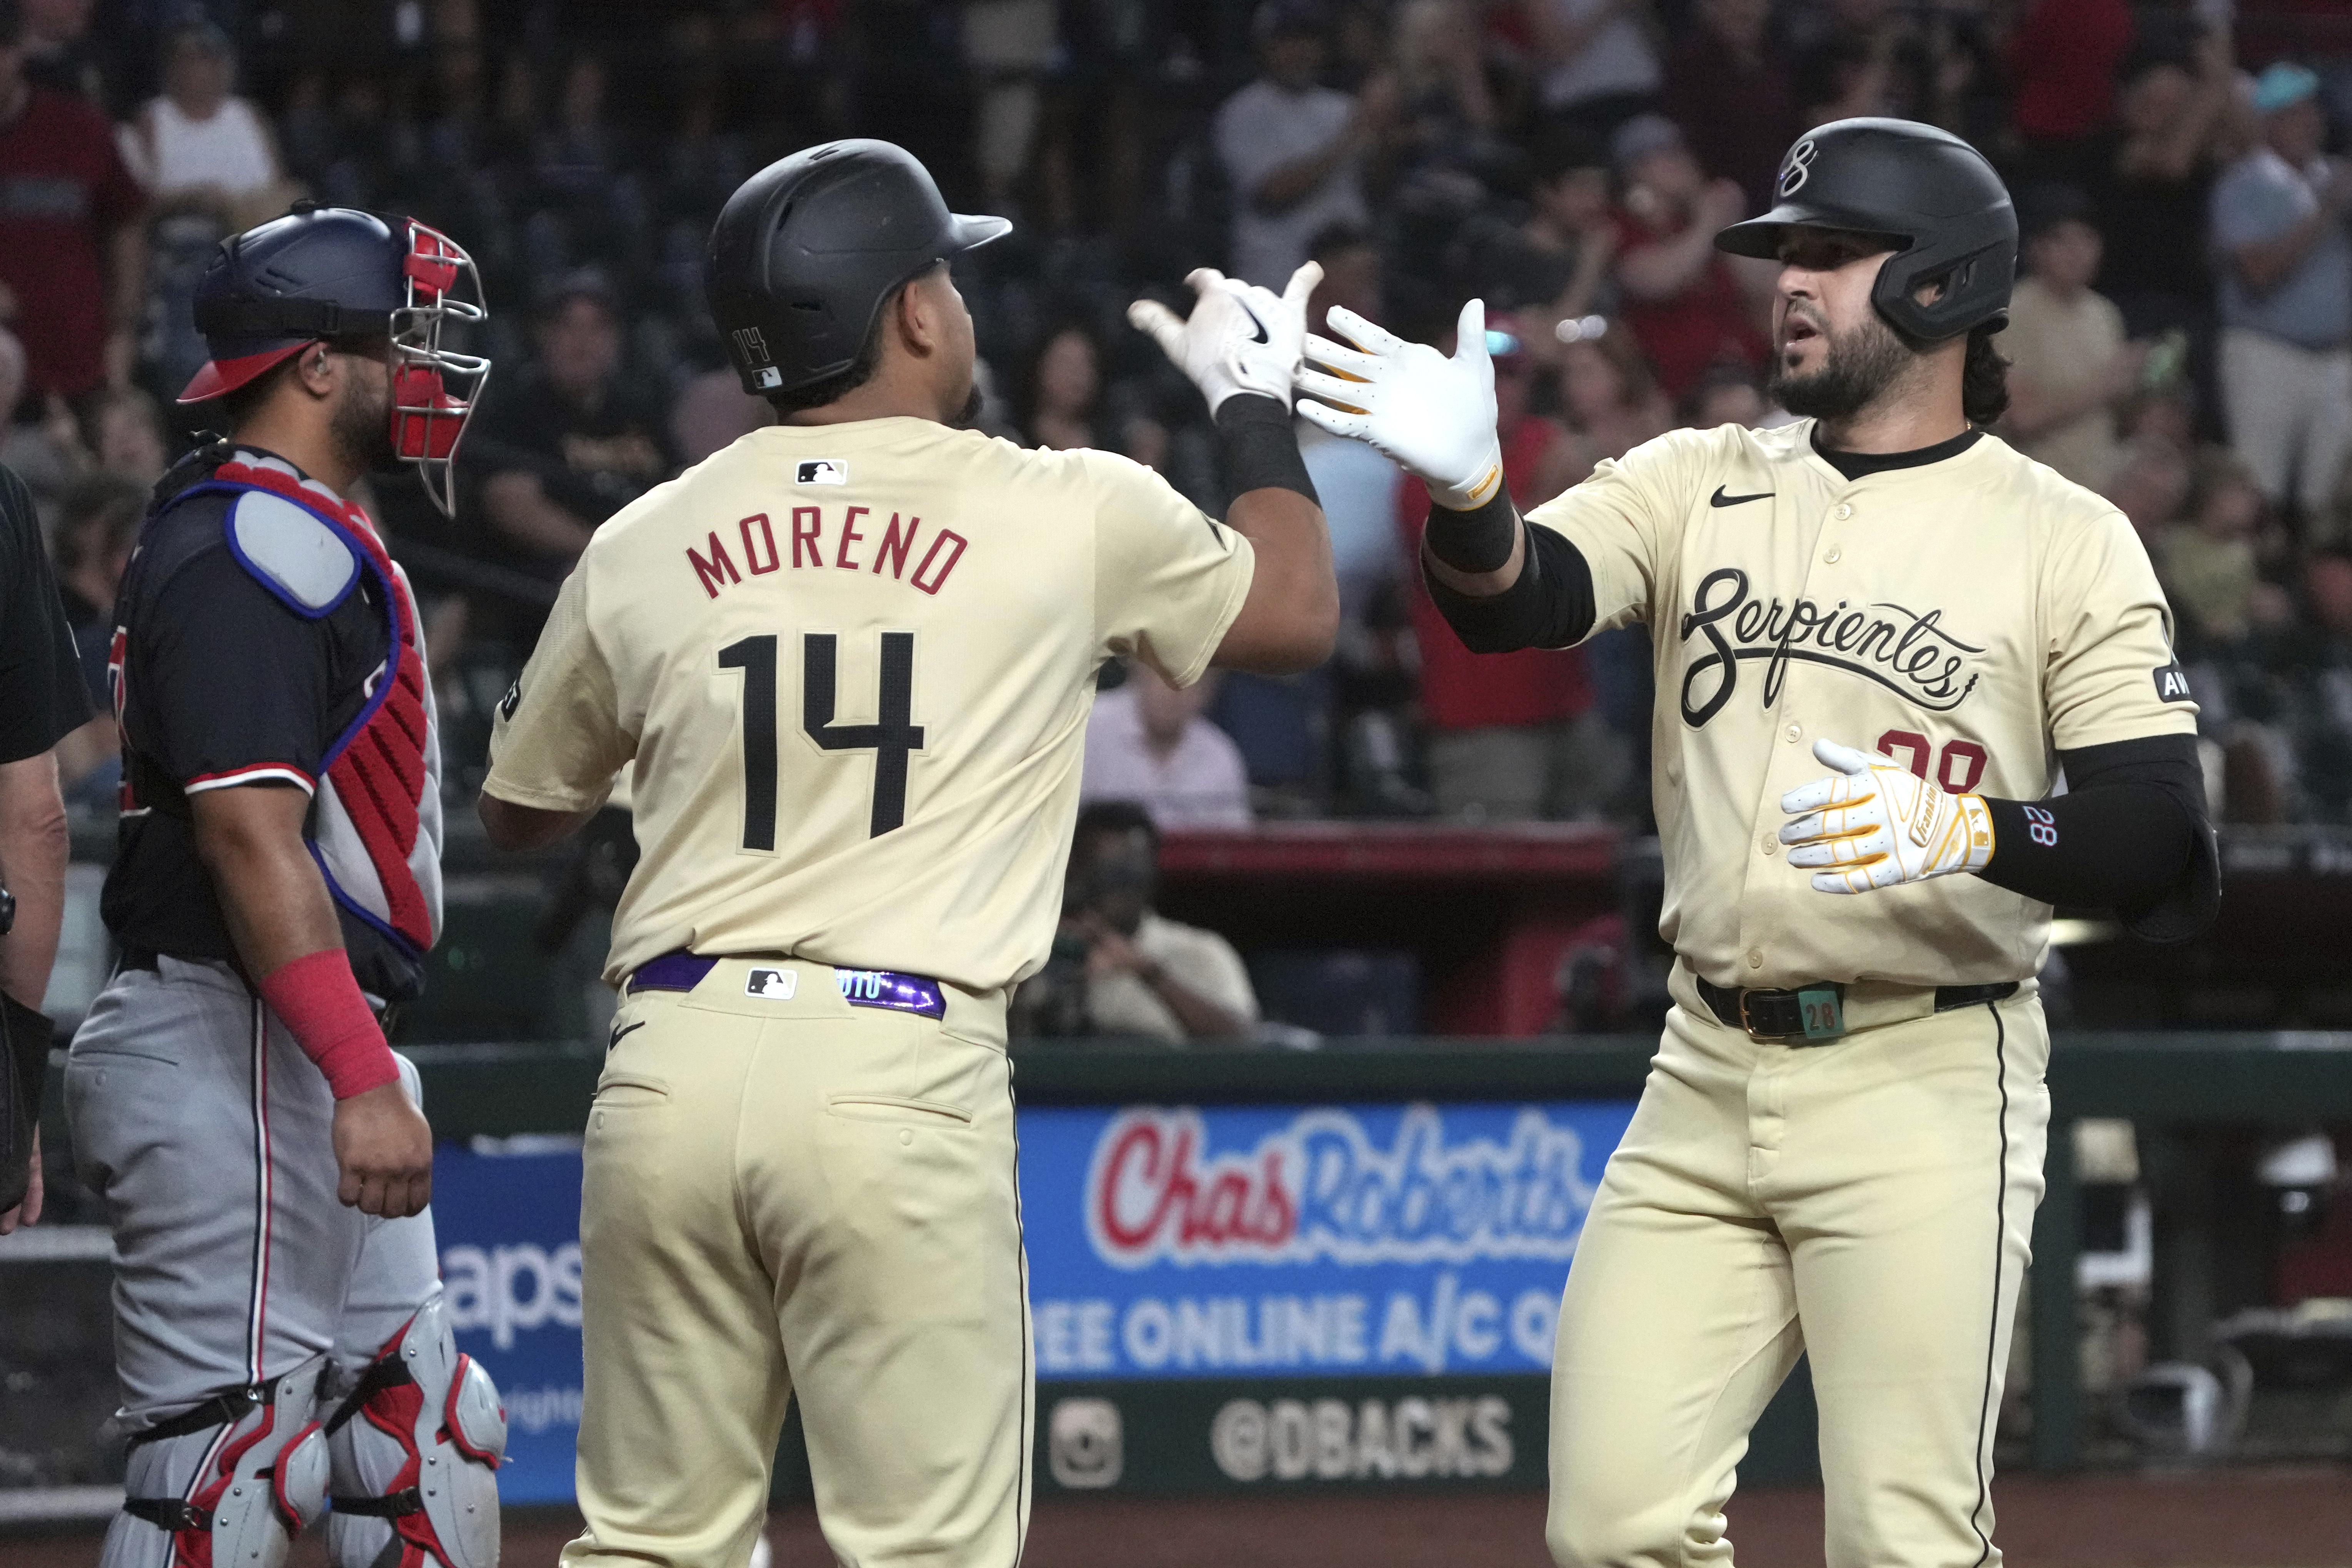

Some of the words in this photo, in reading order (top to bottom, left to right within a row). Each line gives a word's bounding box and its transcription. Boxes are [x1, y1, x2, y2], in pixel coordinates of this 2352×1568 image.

[732, 327, 770, 364] 14
[685, 505, 969, 600] MORENO
[1681, 568, 1986, 728] Serpientes
[718, 632, 924, 851] 14
[2023, 805, 2057, 846] 28
[1806, 1002, 1835, 1031] 28
[1093, 1114, 1300, 1256] Chas
[1032, 1299, 1117, 1372] EE
[1121, 1294, 1369, 1368] ONLINE
[1379, 1272, 1504, 1374] A/C
[1210, 1396, 1515, 1481] @DBACKS
